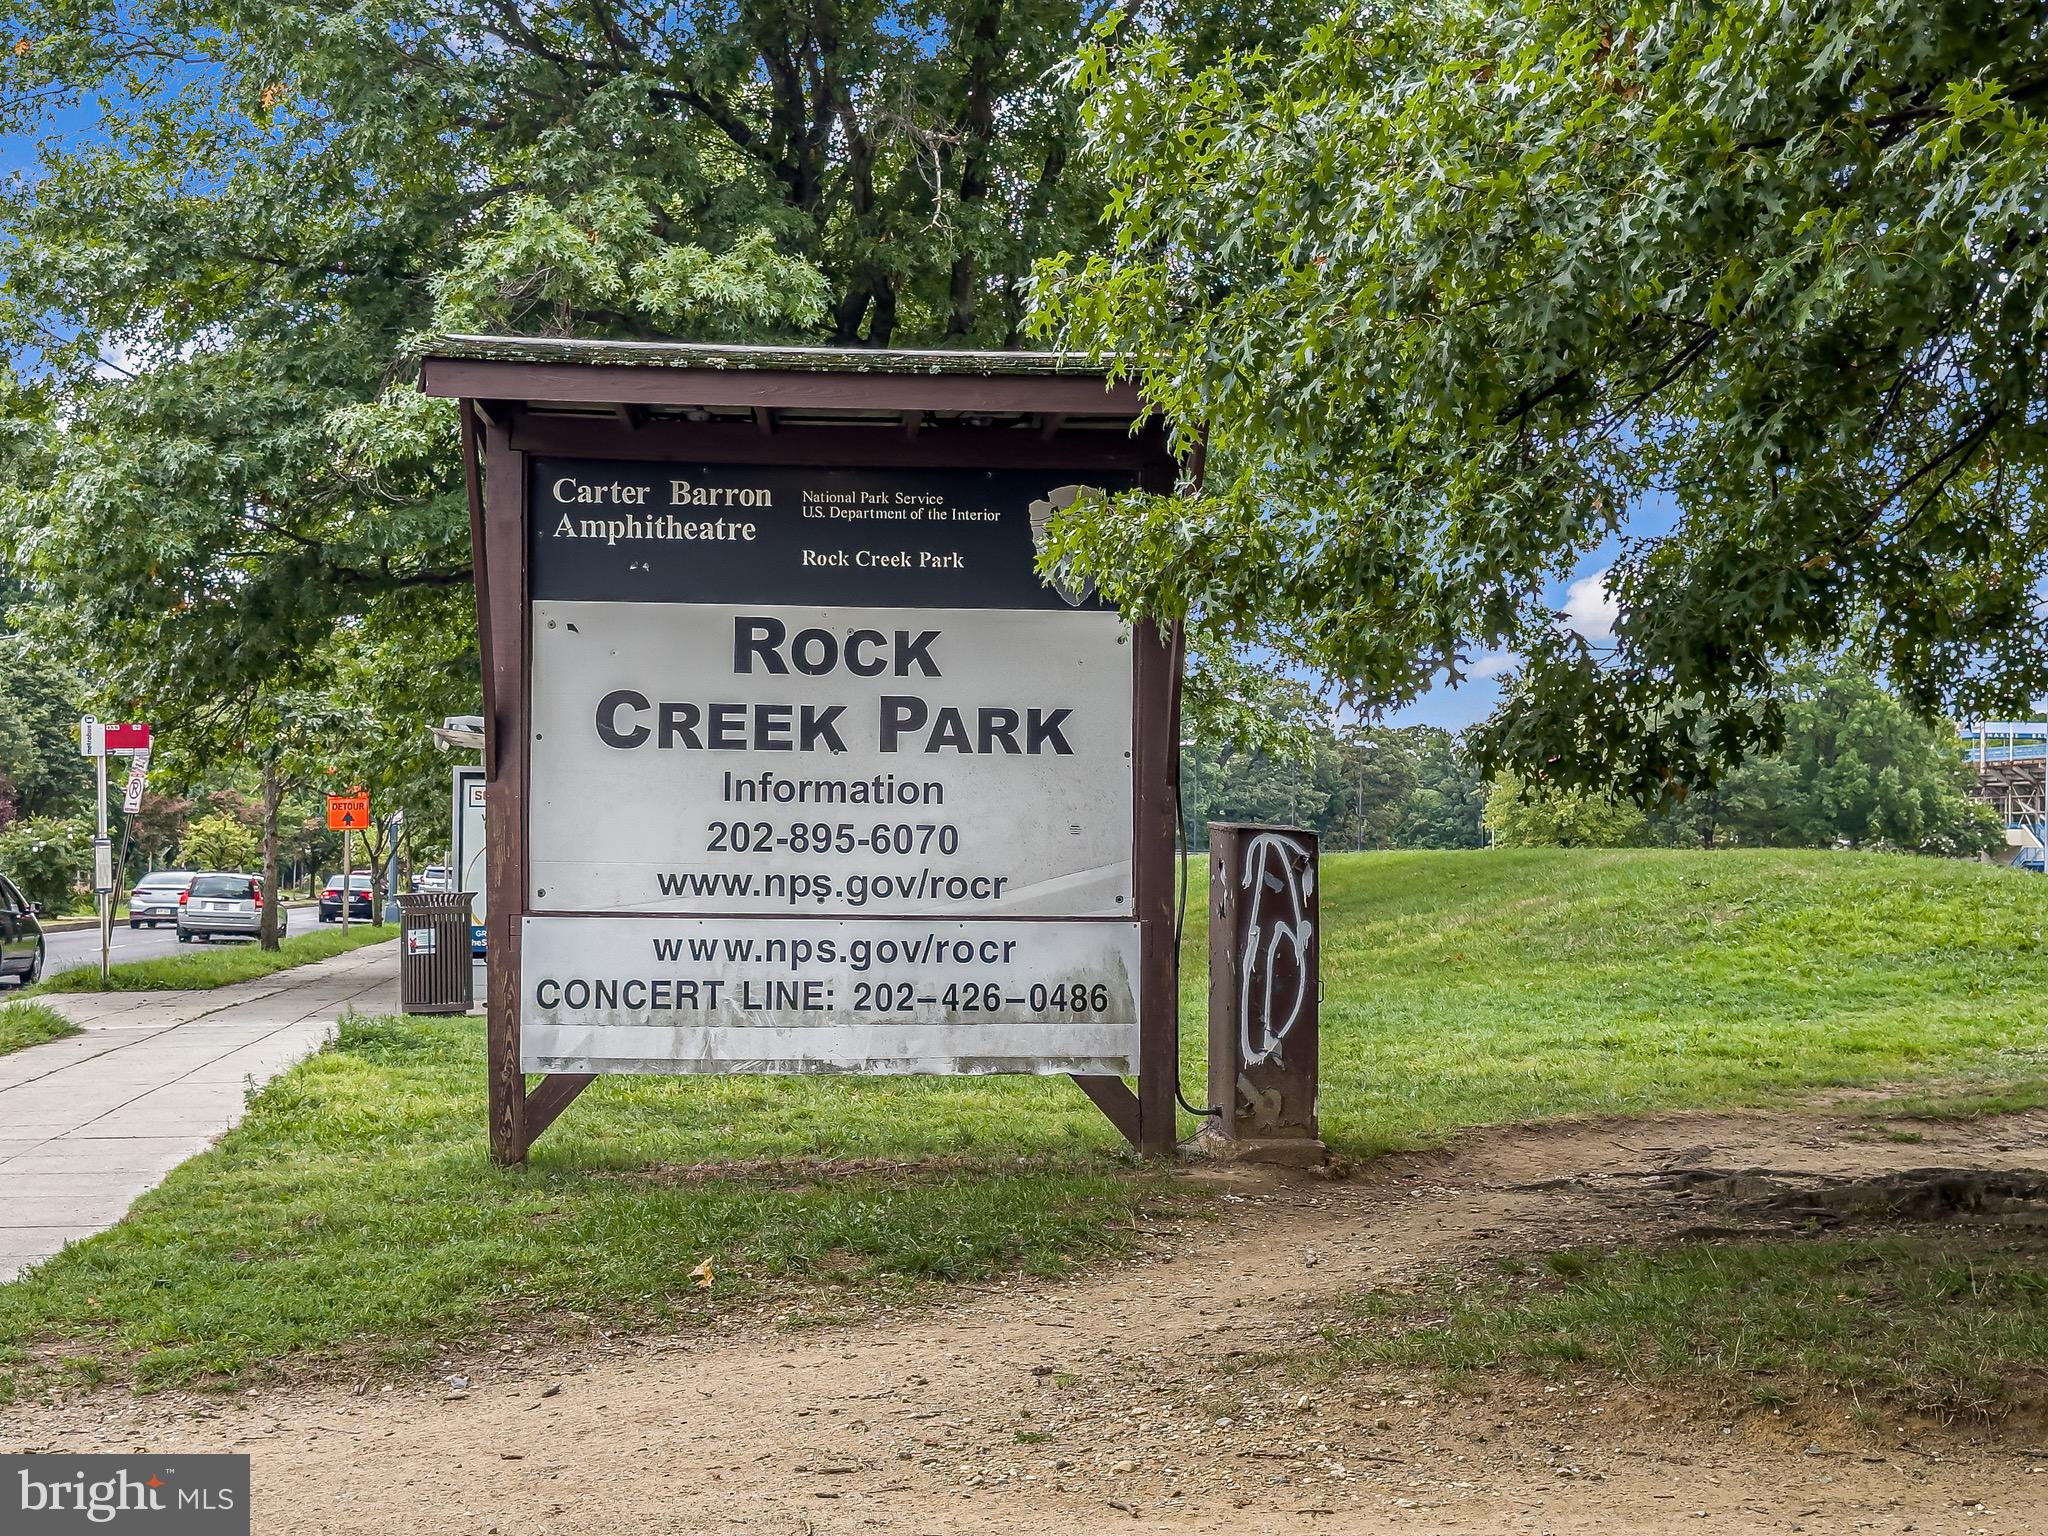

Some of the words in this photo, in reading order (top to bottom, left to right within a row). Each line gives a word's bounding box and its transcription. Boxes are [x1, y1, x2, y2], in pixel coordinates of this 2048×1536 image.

[552, 477, 651, 505] Carter
[669, 480, 773, 507] Barron
[802, 490, 856, 504] National
[860, 491, 890, 504] Park
[895, 491, 944, 505] Service
[552, 512, 757, 546] Amphitheatre
[802, 506, 826, 519] U.S.
[829, 506, 908, 522] Department
[910, 507, 925, 520] of
[927, 508, 948, 521] the
[951, 508, 1001, 521] Interior
[801, 549, 850, 567] Rock
[855, 550, 912, 568] Creek
[919, 551, 965, 568] Park
[733, 616, 943, 677] ROCK
[595, 689, 849, 753] CREEK
[879, 695, 1075, 756] PARK
[723, 771, 945, 805] Information
[332, 802, 365, 811] DETOUR
[706, 821, 959, 856] 202-895-6070
[656, 868, 1009, 907] www.nps.gov/rocr
[652, 933, 1017, 971] www.nps.gov/rocr
[535, 978, 726, 1012] CONCERT
[743, 981, 835, 1013] LINE:
[853, 982, 1110, 1014] 202-426-0486
